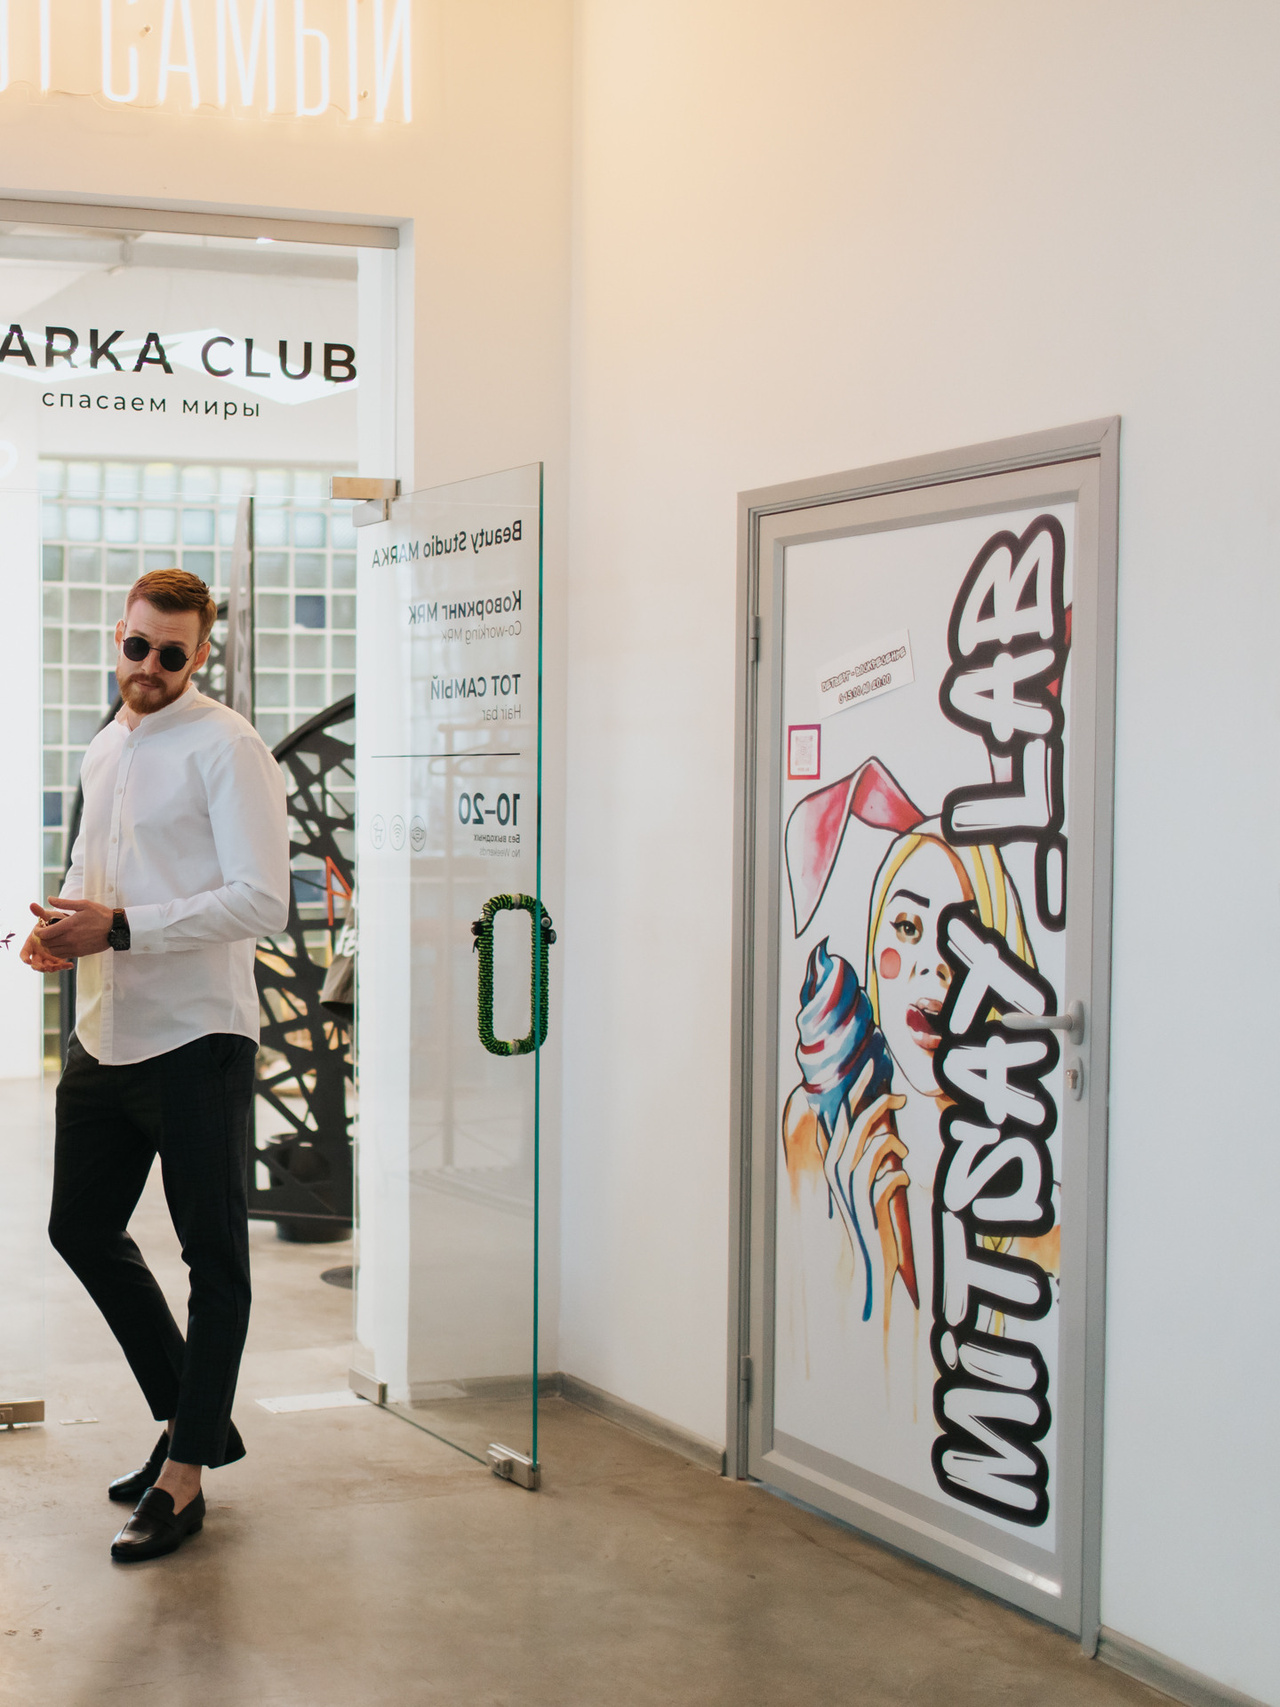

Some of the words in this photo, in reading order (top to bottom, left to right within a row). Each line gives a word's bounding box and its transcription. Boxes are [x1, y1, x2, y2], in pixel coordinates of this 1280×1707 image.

[201, 335, 358, 383] CLUB
[41, 391, 167, 413] спасаем
[182, 399, 260, 420] миры
